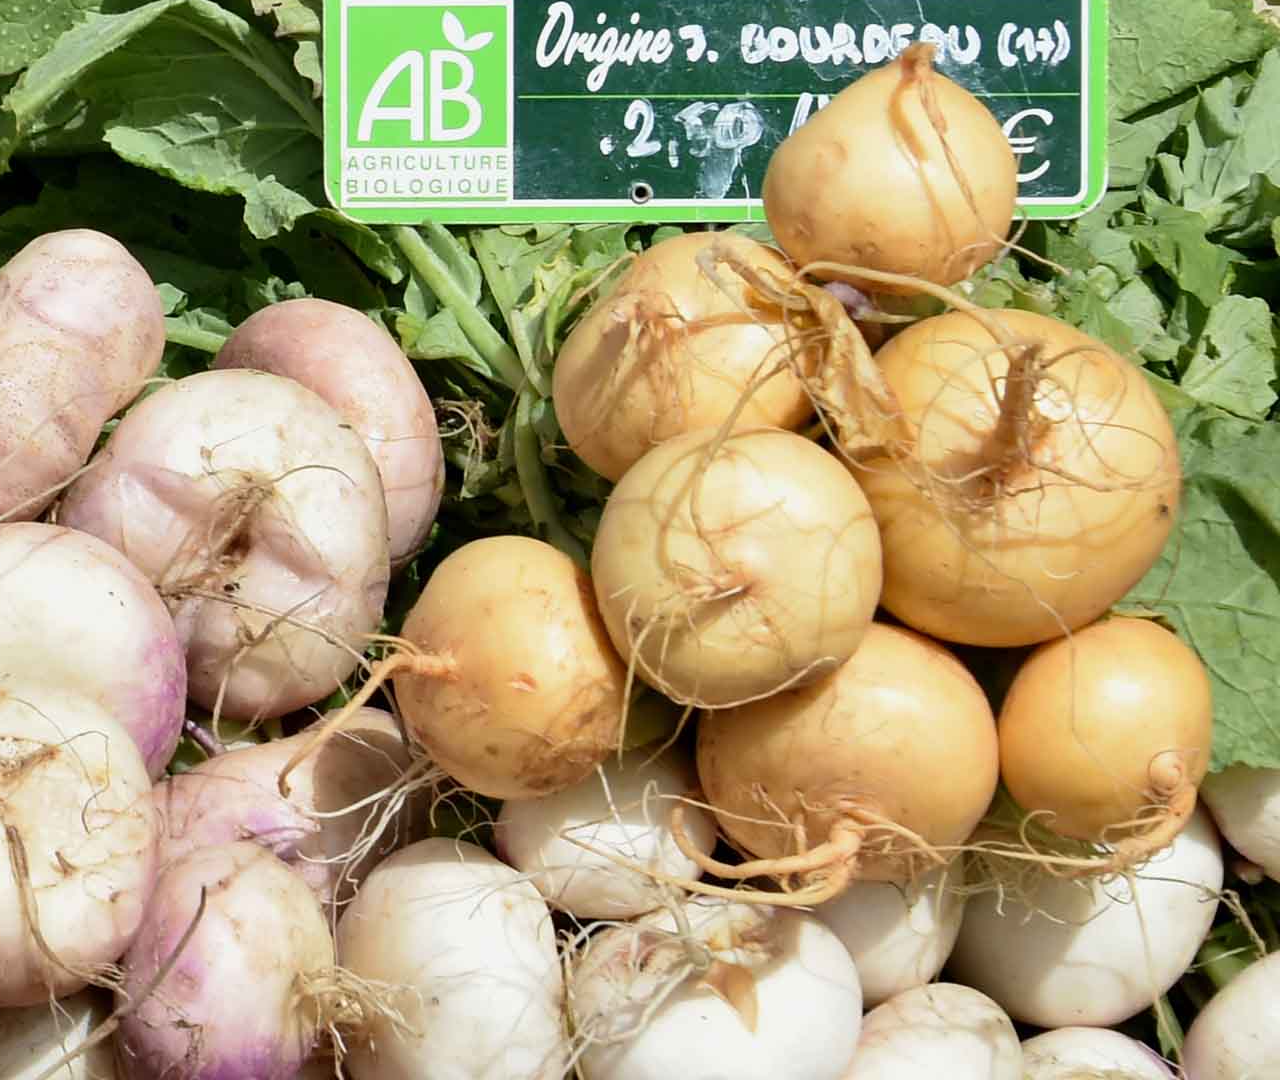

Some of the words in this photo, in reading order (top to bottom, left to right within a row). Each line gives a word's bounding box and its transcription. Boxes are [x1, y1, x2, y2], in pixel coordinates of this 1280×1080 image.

[536, 1, 674, 93] Origine
[356, 49, 483, 142] AB
[345, 178, 508, 195] BIOLOGIQUE
[346, 154, 508, 171] AGRICULTURE
